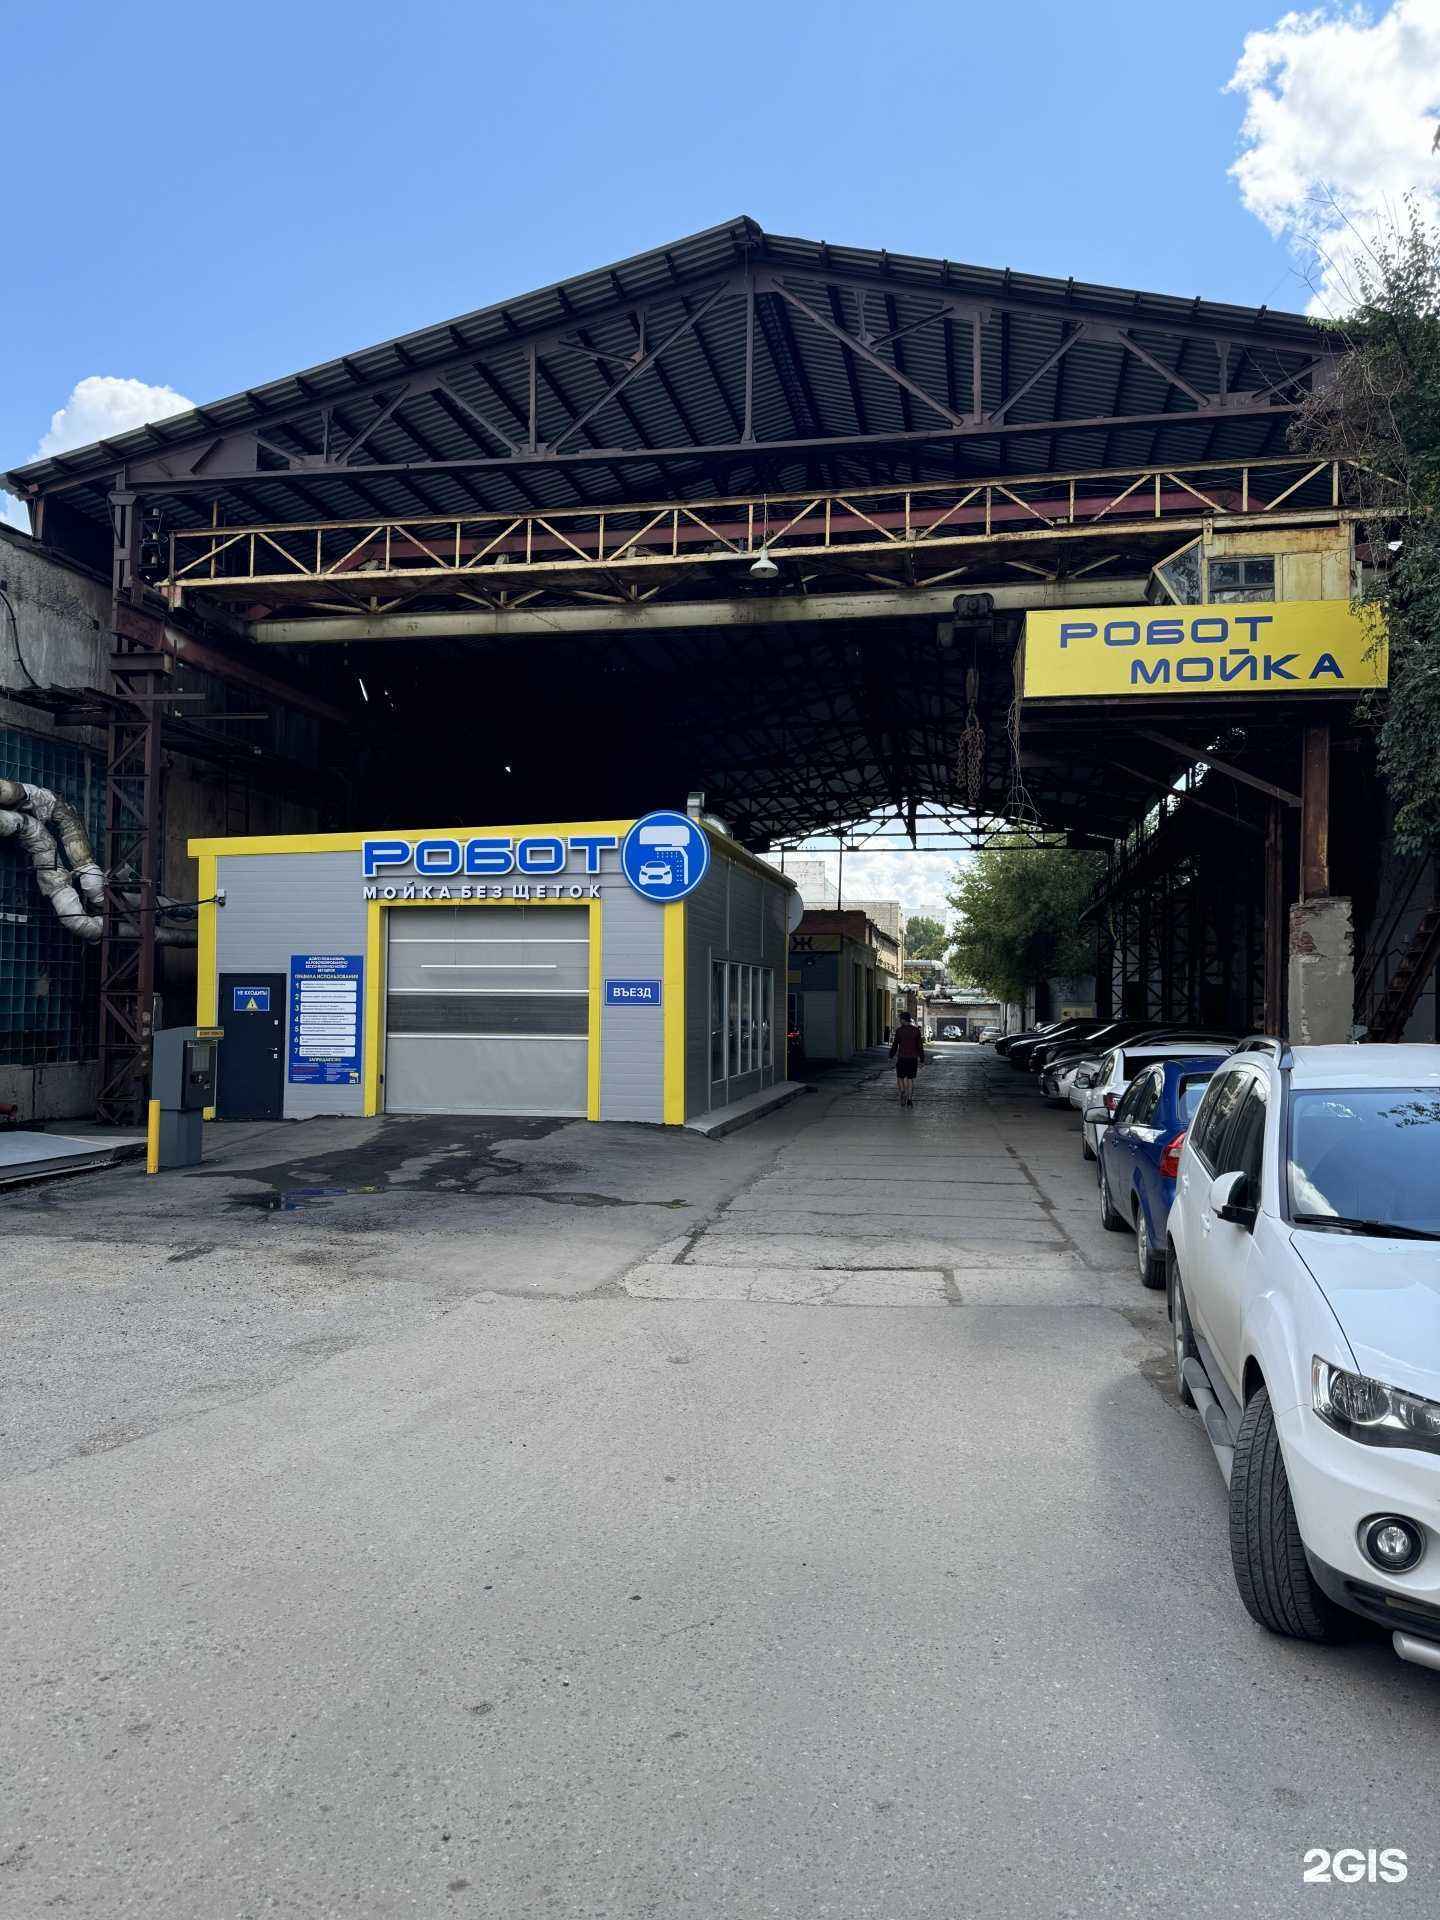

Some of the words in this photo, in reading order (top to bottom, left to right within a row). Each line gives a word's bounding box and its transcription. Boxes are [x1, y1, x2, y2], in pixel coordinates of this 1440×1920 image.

[1060, 615, 1273, 648] РОБОТ
[1130, 648, 1345, 684] МОЙКА
[362, 836, 618, 877] РОБОТ
[363, 881, 451, 899] МОЙКА
[461, 884, 503, 899] БЕЗ
[512, 884, 601, 900] ЩЕТОК
[613, 987, 652, 999] ВЪЕЗД
